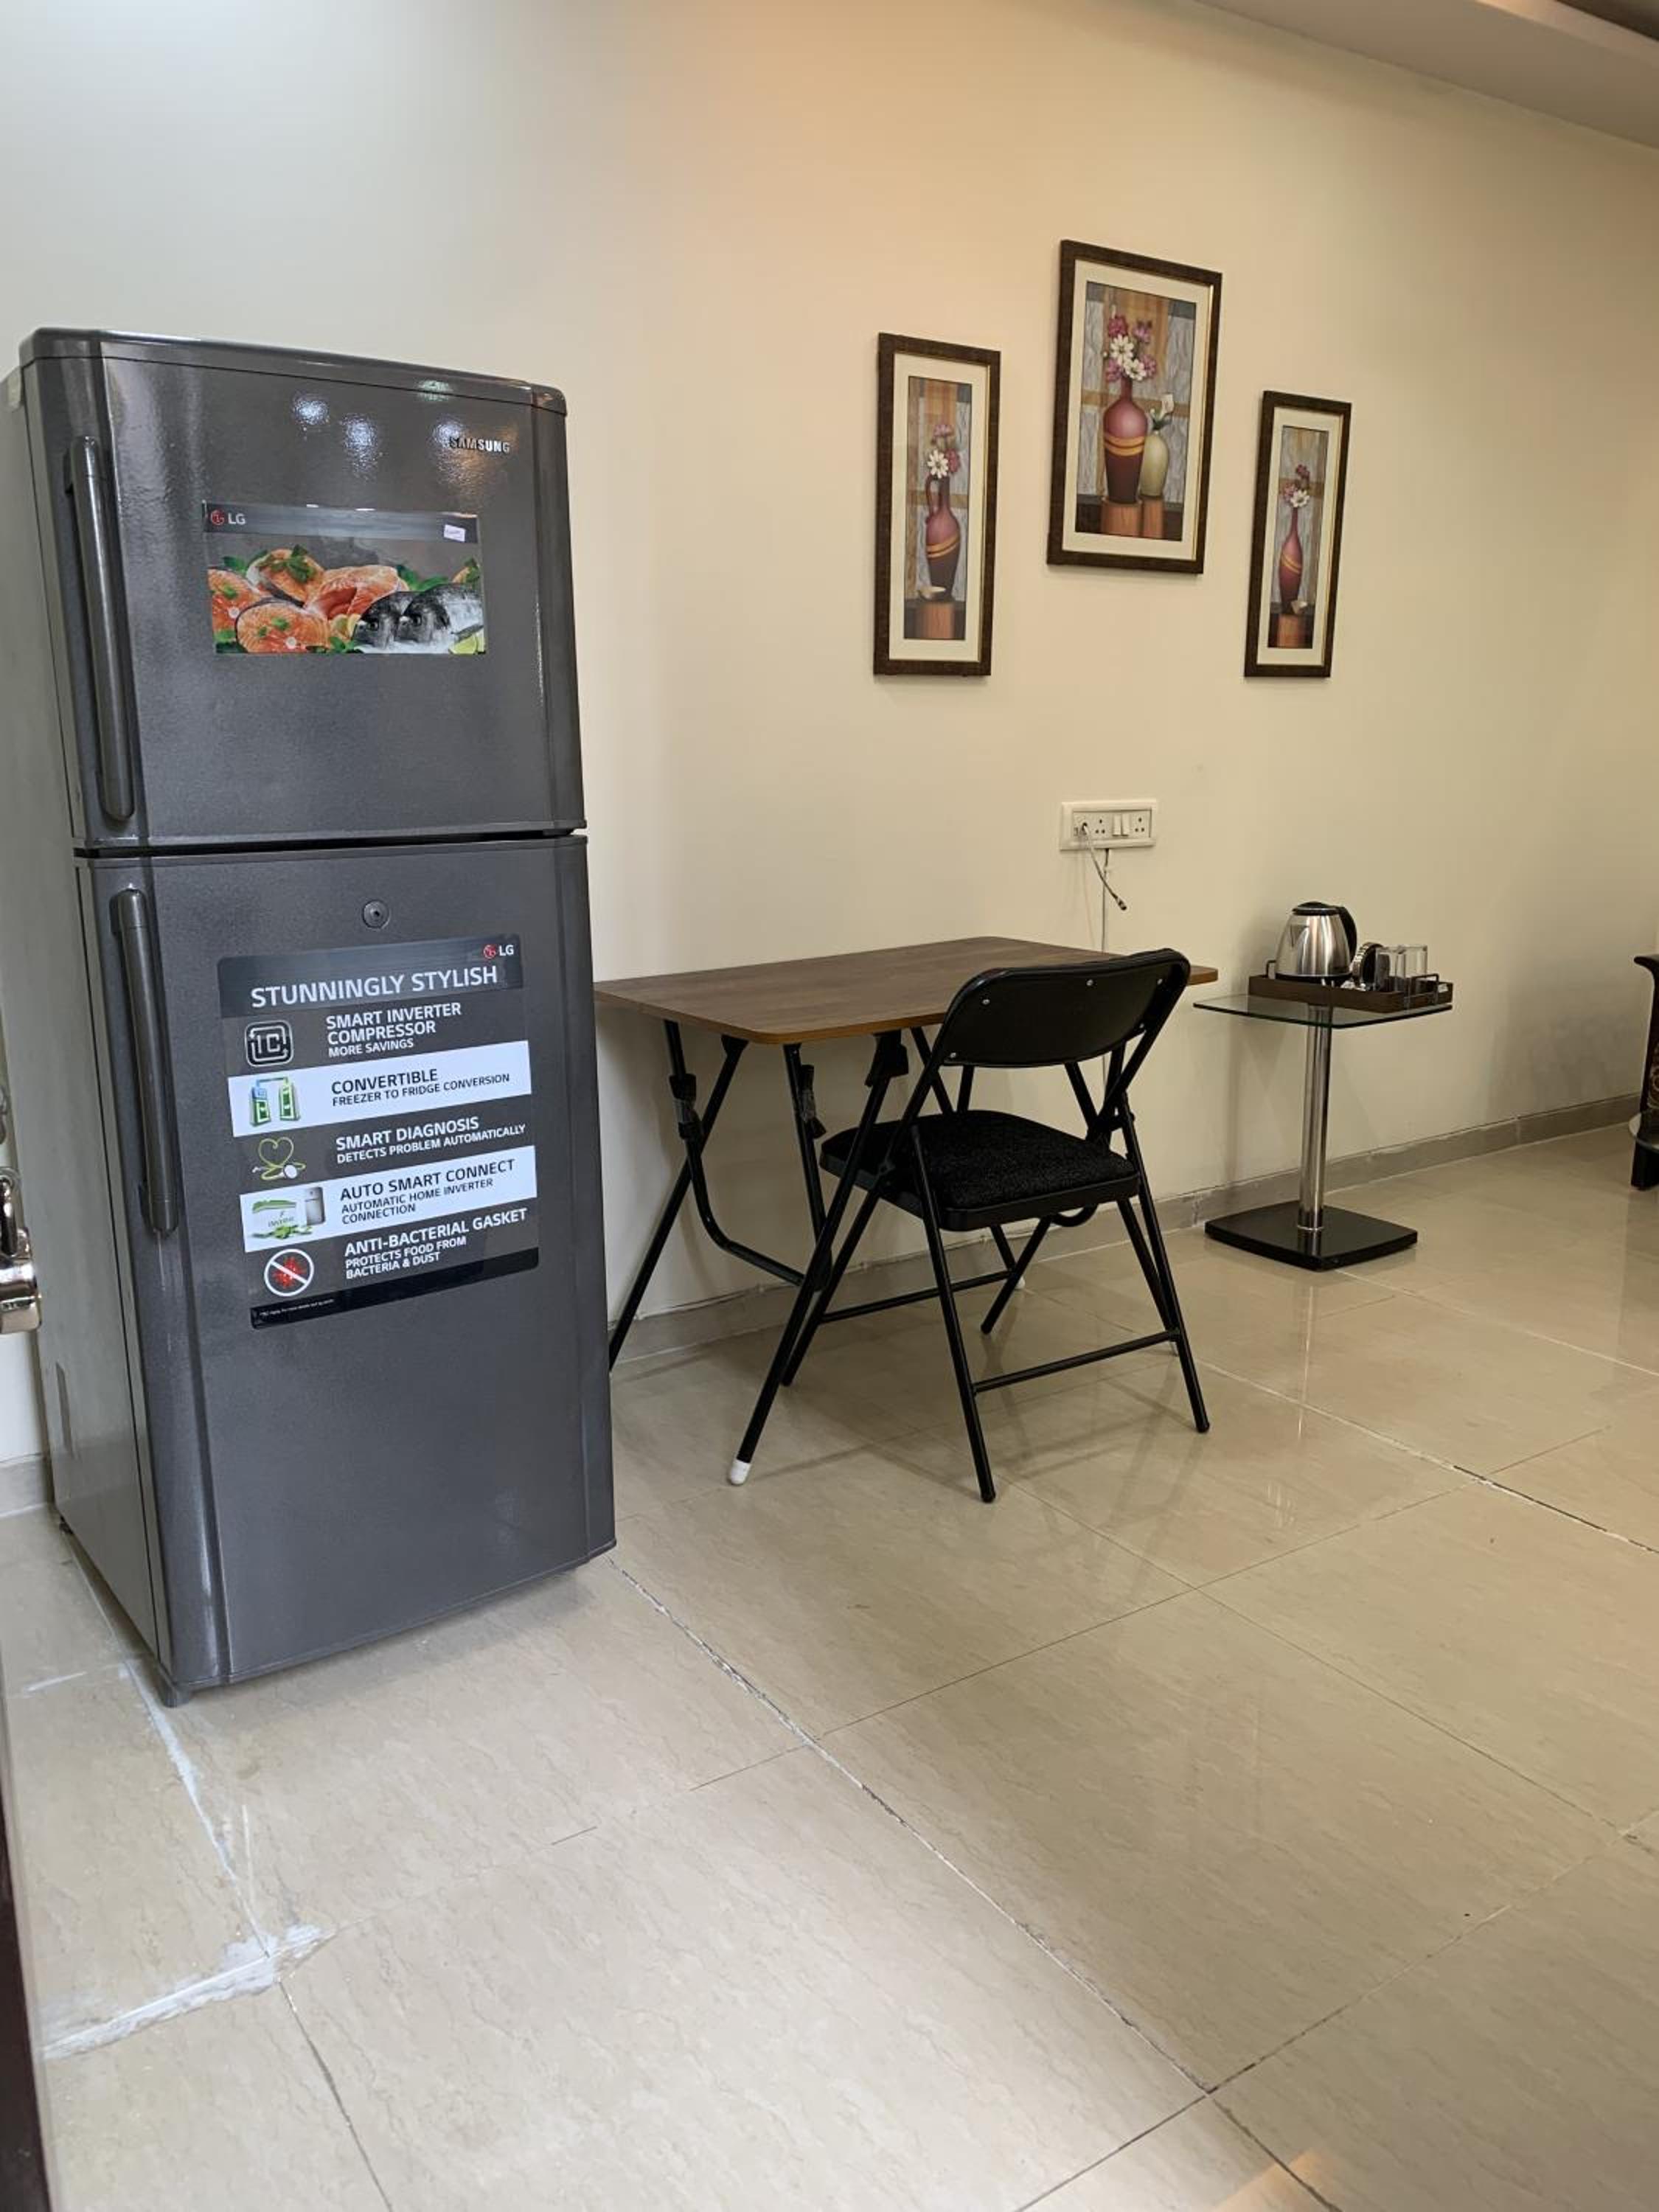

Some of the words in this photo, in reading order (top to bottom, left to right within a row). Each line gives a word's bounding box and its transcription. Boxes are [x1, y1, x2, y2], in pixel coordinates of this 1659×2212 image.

[450, 437, 510, 453] SAMSUNG
[228, 512, 246, 525] LG
[499, 945, 514, 956] LG
[251, 975, 403, 1008] STUNNINGLY
[411, 965, 497, 992] STYLISH
[326, 1011, 381, 1030] SMART
[386, 1003, 461, 1025] INVERTER
[327, 1020, 436, 1045] COMPRESSOR
[328, 1045, 363, 1058] MORE
[365, 1038, 414, 1053] SAVINGS
[331, 1069, 438, 1095] CONVERTIBLE
[333, 1089, 381, 1107] FREEZER
[384, 1087, 400, 1099] TO
[402, 1083, 441, 1098] FRIDGE
[443, 1074, 510, 1091] CONVERSION
[335, 1130, 392, 1151] SMART
[396, 1116, 479, 1141] DIAGNOSIS
[337, 1148, 387, 1164] DETECTS
[389, 1138, 441, 1156] PROBLEM
[443, 1124, 526, 1146] AUTOMATICALLY
[340, 1183, 384, 1201] AUTO
[389, 1172, 441, 1193] SMART
[445, 1158, 515, 1181] CONNECT
[341, 1194, 406, 1214] AUTOMATIC
[408, 1189, 441, 1203] HOME
[444, 1178, 493, 1195] INVERTER
[341, 1204, 416, 1225] CONNECTION
[344, 1222, 469, 1256] ANTI-BACTERIAL
[473, 1208, 528, 1229] GASKET
[345, 1249, 402, 1268] PROTECTS
[403, 1242, 435, 1256] FOOD
[437, 1237, 467, 1251] FROM
[347, 1262, 400, 1279] BACTERIA
[402, 1258, 411, 1268] &
[412, 1253, 441, 1267] DUST
